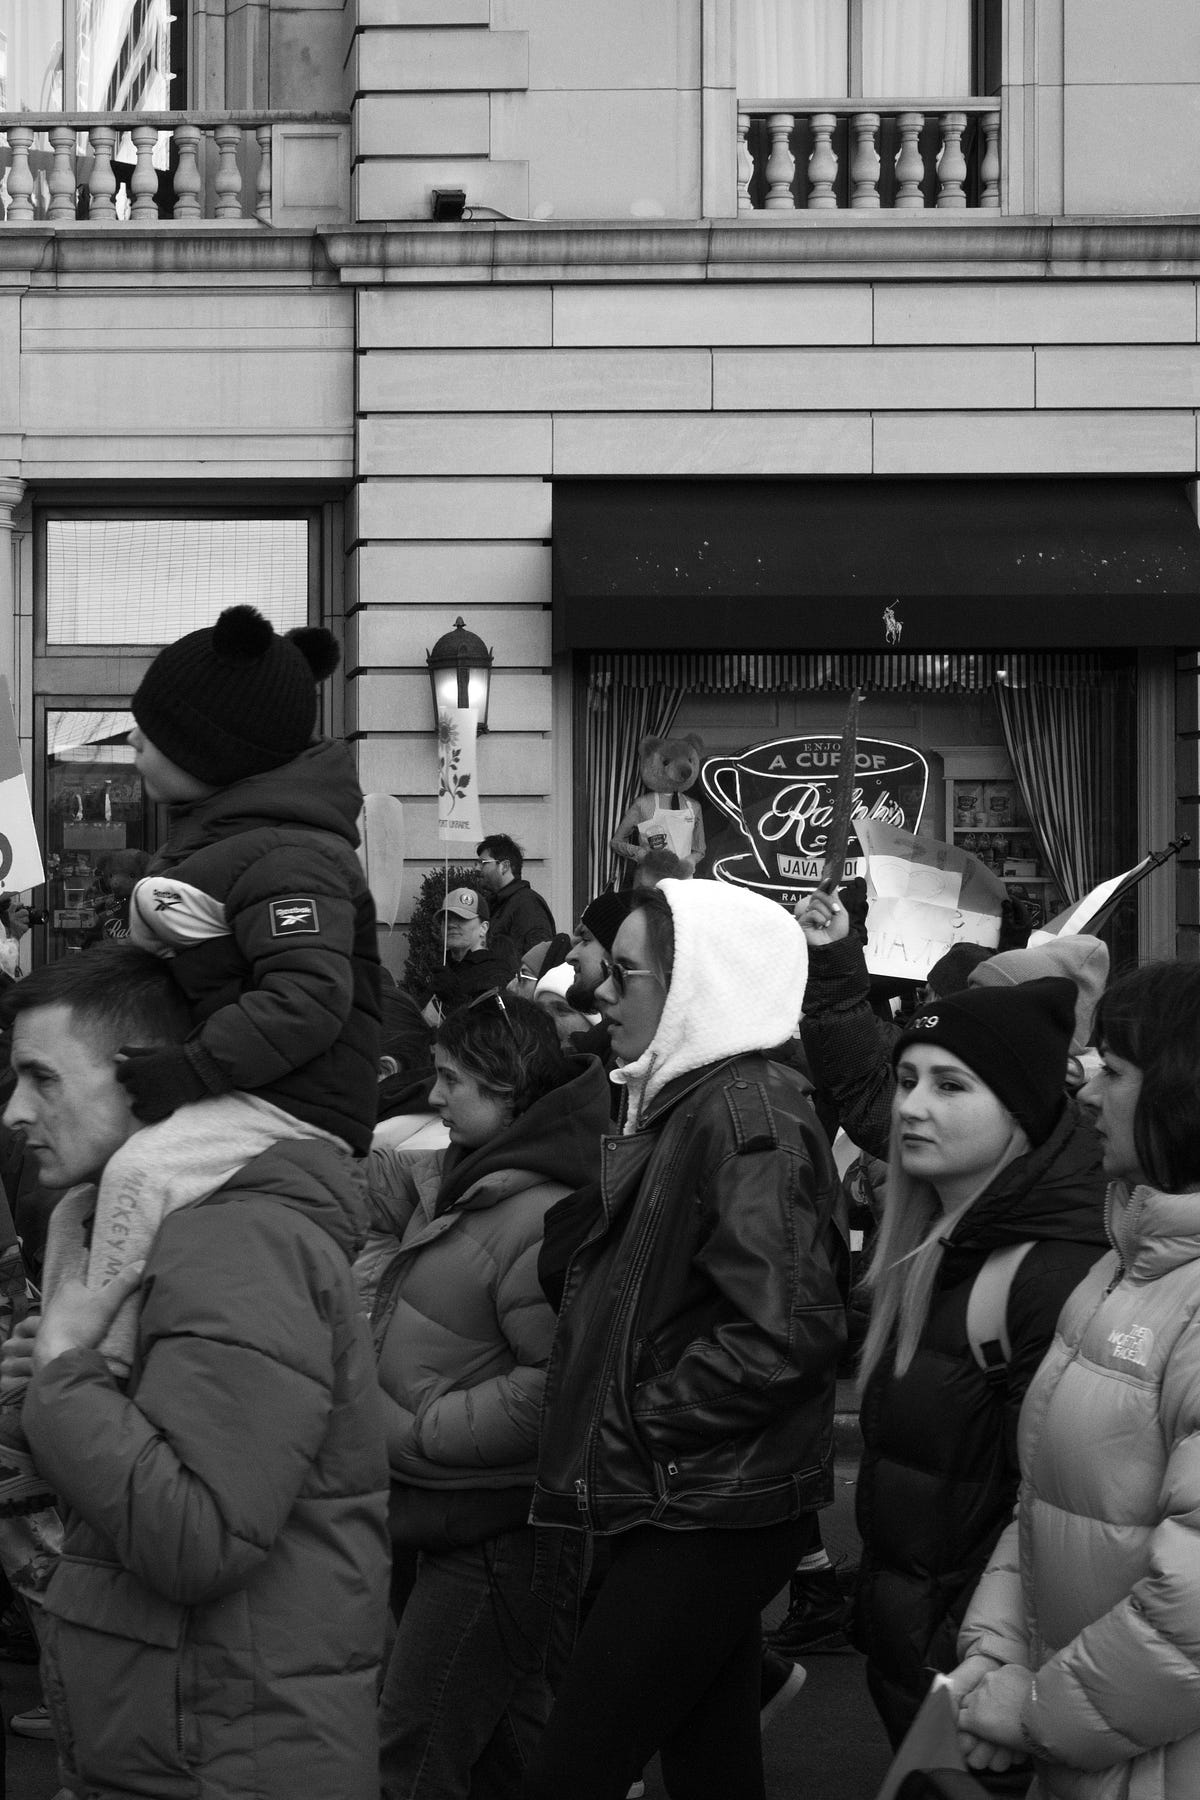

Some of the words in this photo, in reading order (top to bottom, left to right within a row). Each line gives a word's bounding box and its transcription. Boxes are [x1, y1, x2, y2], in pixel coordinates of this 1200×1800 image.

[803, 743, 841, 752] ENJO
[767, 754, 788, 771] A
[795, 752, 842, 768] CUP
[855, 753, 888, 770] OF
[783, 860, 818, 877] JAVA
[104, 1166, 149, 1252] MICKEY
